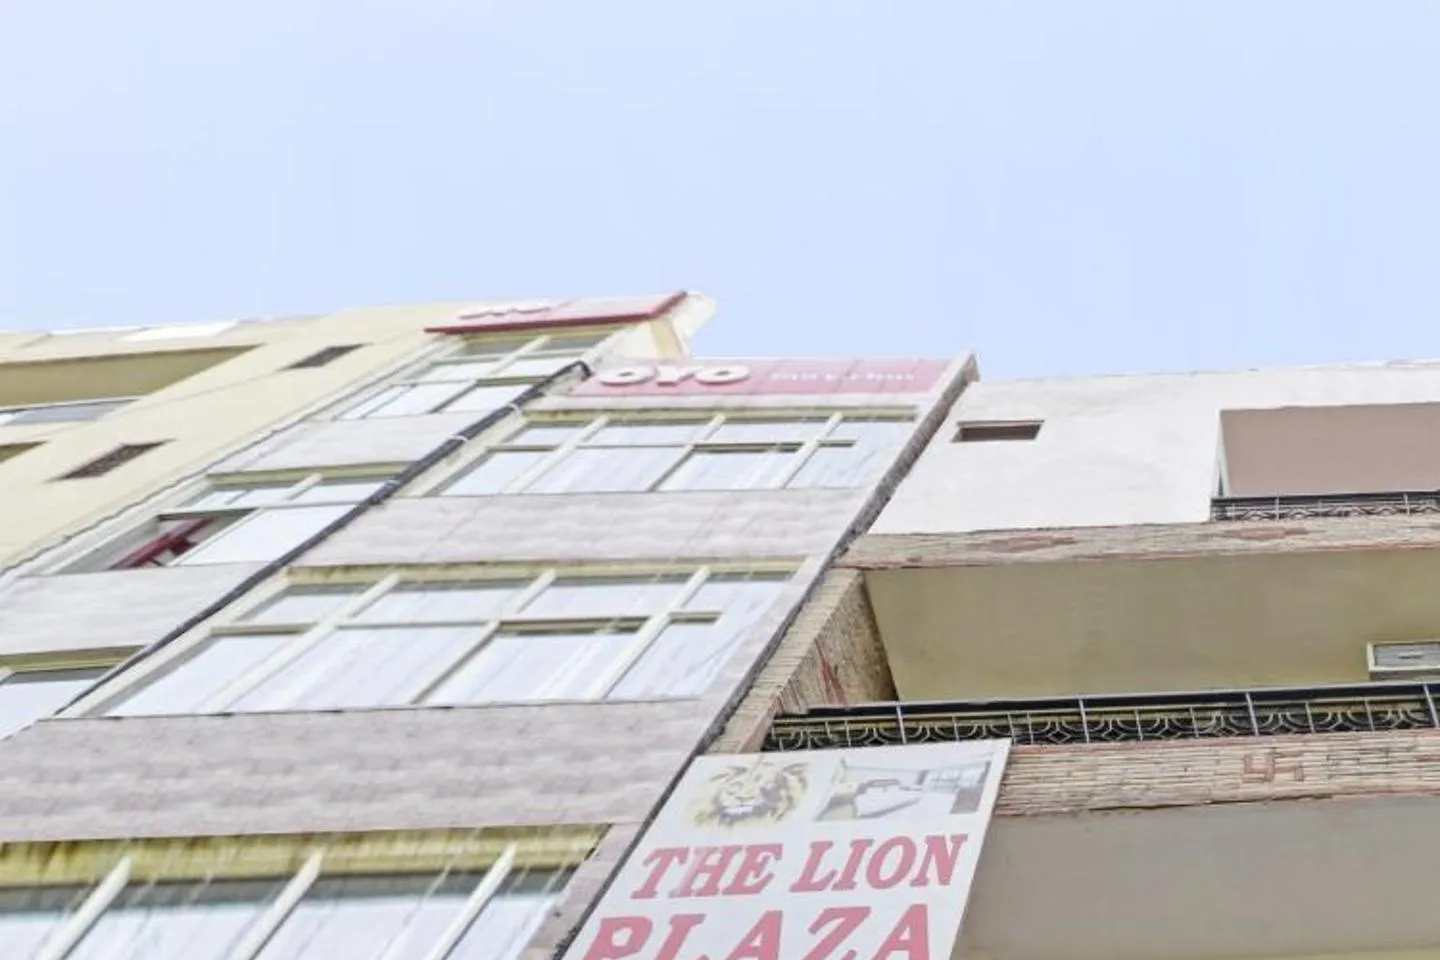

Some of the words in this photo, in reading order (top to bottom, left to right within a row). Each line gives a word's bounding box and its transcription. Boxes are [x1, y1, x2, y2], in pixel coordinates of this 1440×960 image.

[599, 365, 750, 386] OYO
[631, 843, 783, 900] THE
[789, 834, 968, 893] LION
